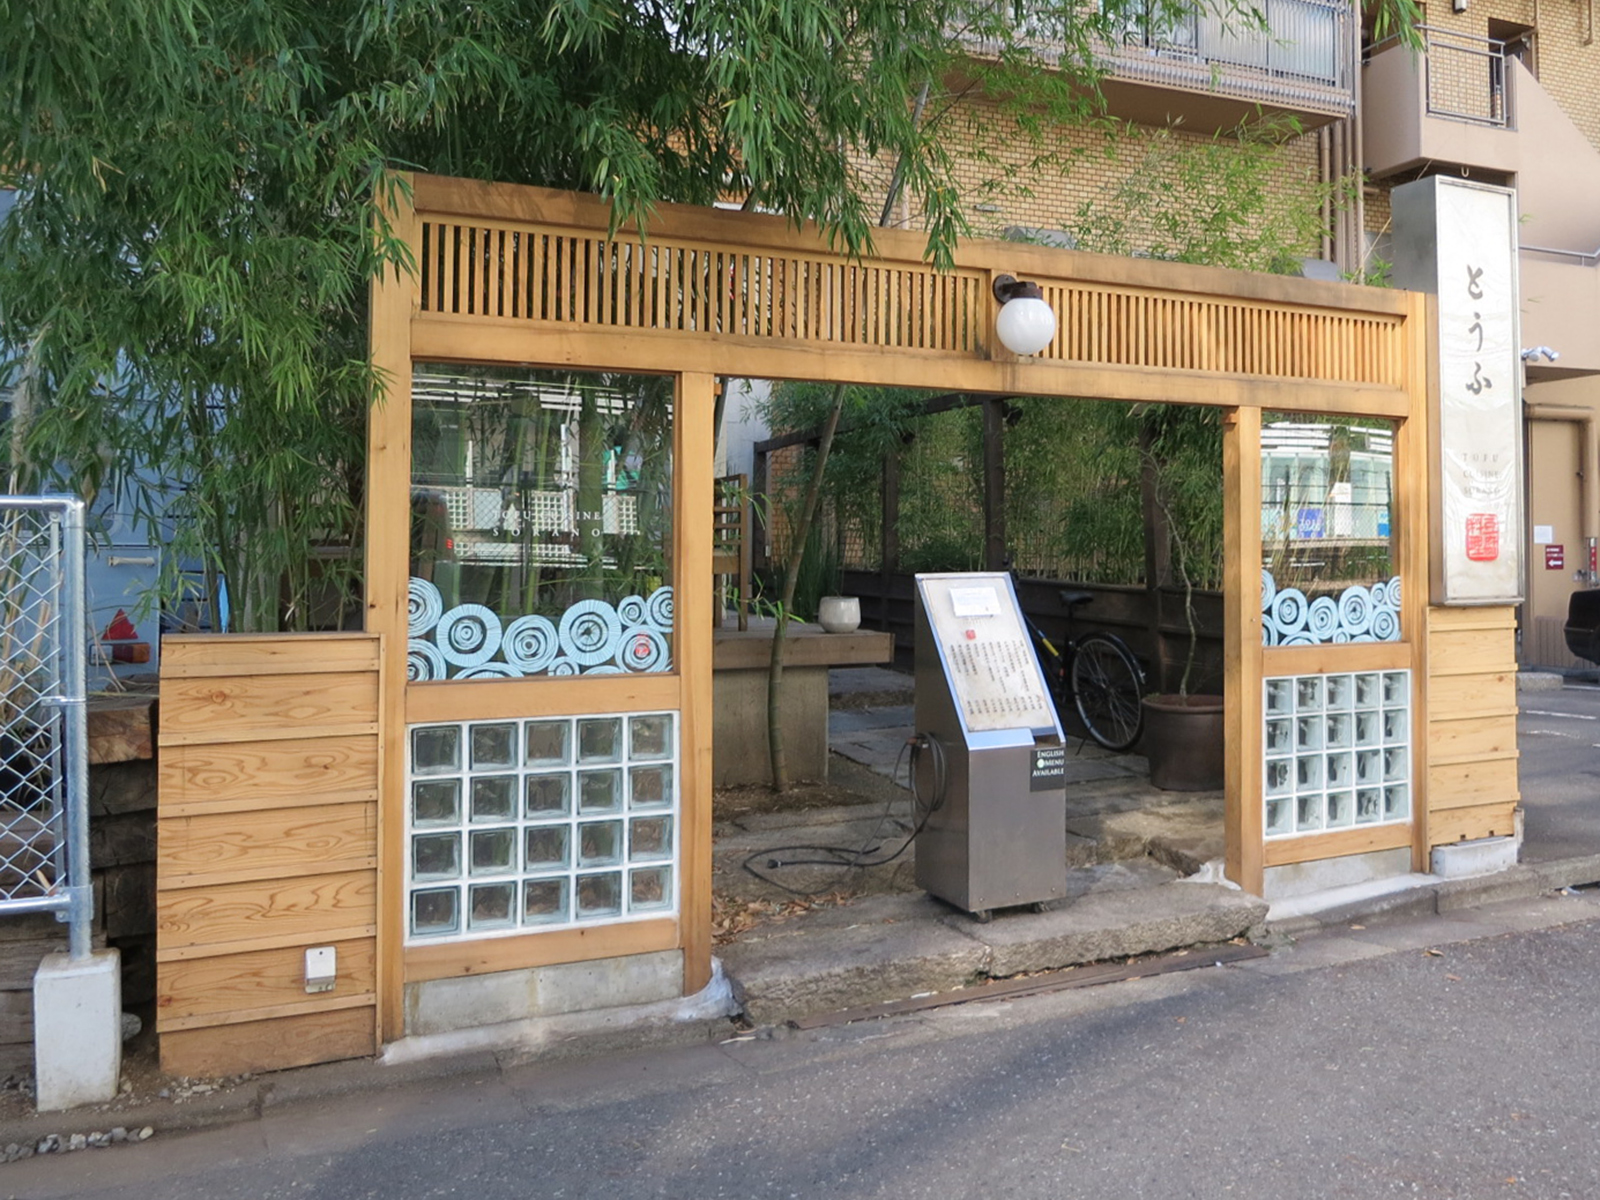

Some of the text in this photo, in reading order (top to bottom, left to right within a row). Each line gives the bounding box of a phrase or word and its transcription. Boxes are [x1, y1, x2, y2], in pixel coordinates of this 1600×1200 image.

[1465, 264, 1493, 395] とうふ
[1462, 453, 1499, 462] TOFU
[1463, 469, 1499, 479] CUSINE
[493, 510, 531, 520] TOFU
[493, 528, 601, 537] SORANO
[1037, 750, 1065, 758] ENGLISH
[1044, 758, 1065, 766] MENU
[1032, 768, 1064, 777] AVAILABLE
